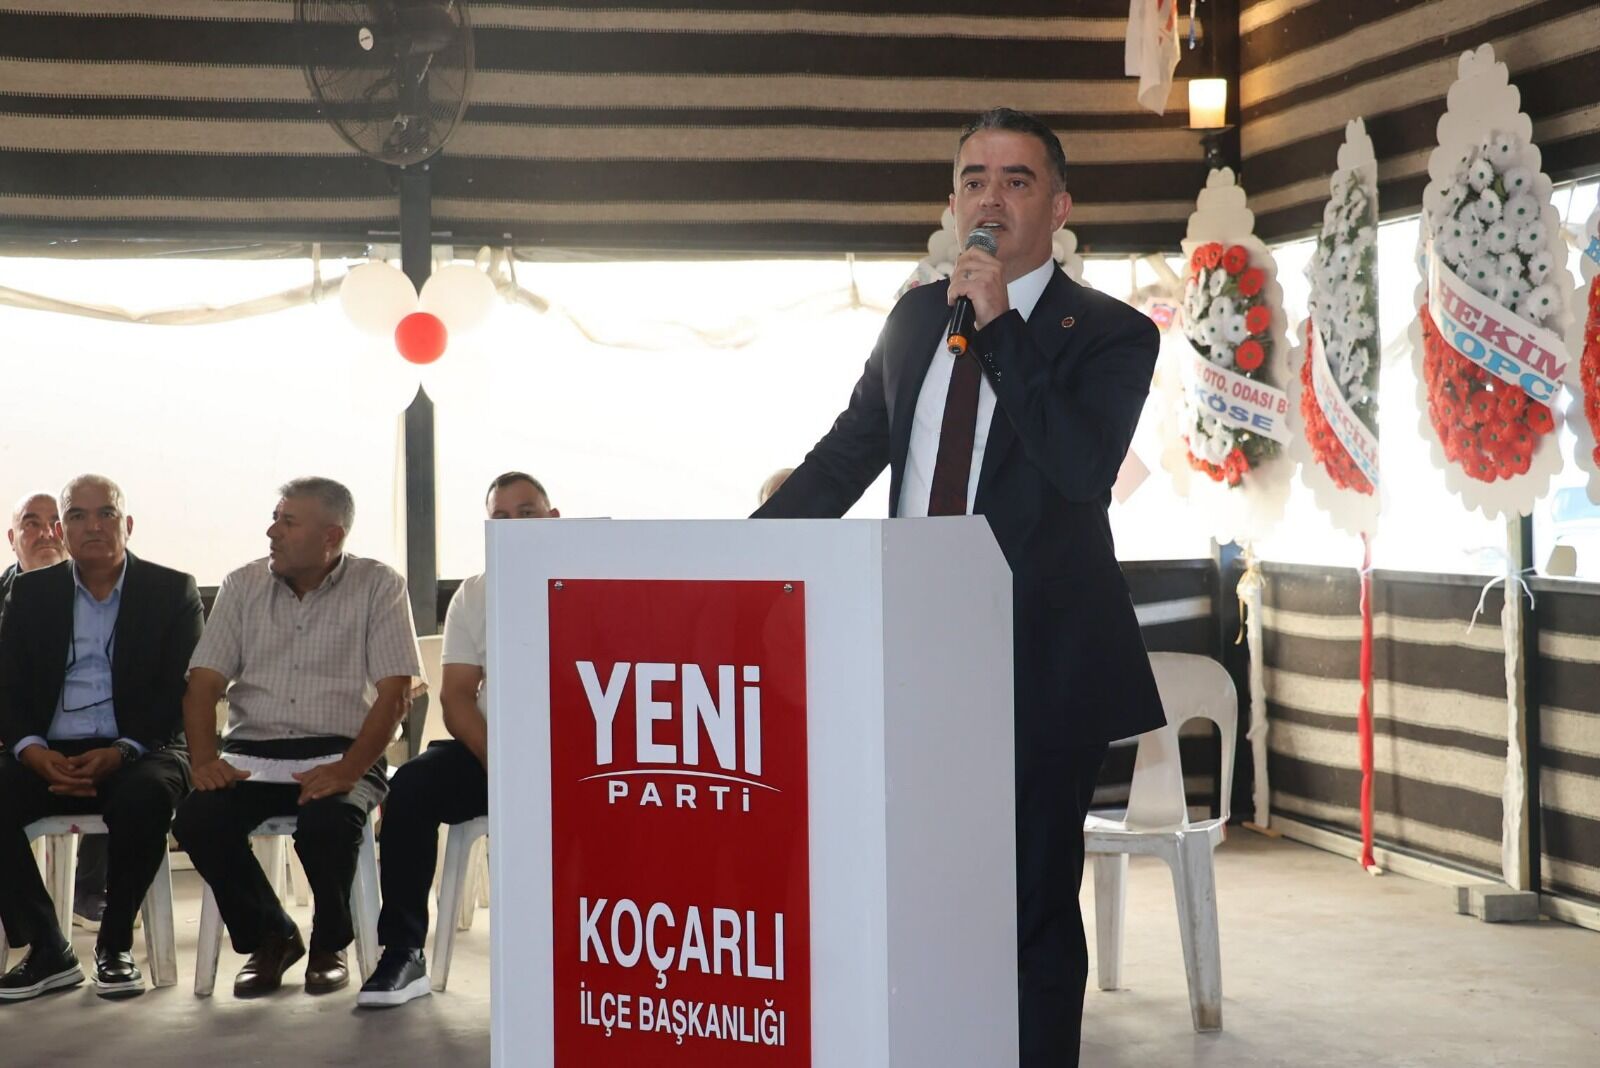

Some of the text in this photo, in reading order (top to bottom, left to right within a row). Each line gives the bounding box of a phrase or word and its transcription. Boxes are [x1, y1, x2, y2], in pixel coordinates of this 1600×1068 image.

[1441, 310, 1559, 401] TOPC
[1195, 384, 1274, 432] KÖSE
[1203, 367, 1228, 393] OTO.
[1231, 381, 1274, 410] ODASI
[1276, 398, 1291, 414] B
[579, 896, 785, 989] KOÇARLI
[580, 981, 785, 1046] İLÇE BAŞKANLIĞI
